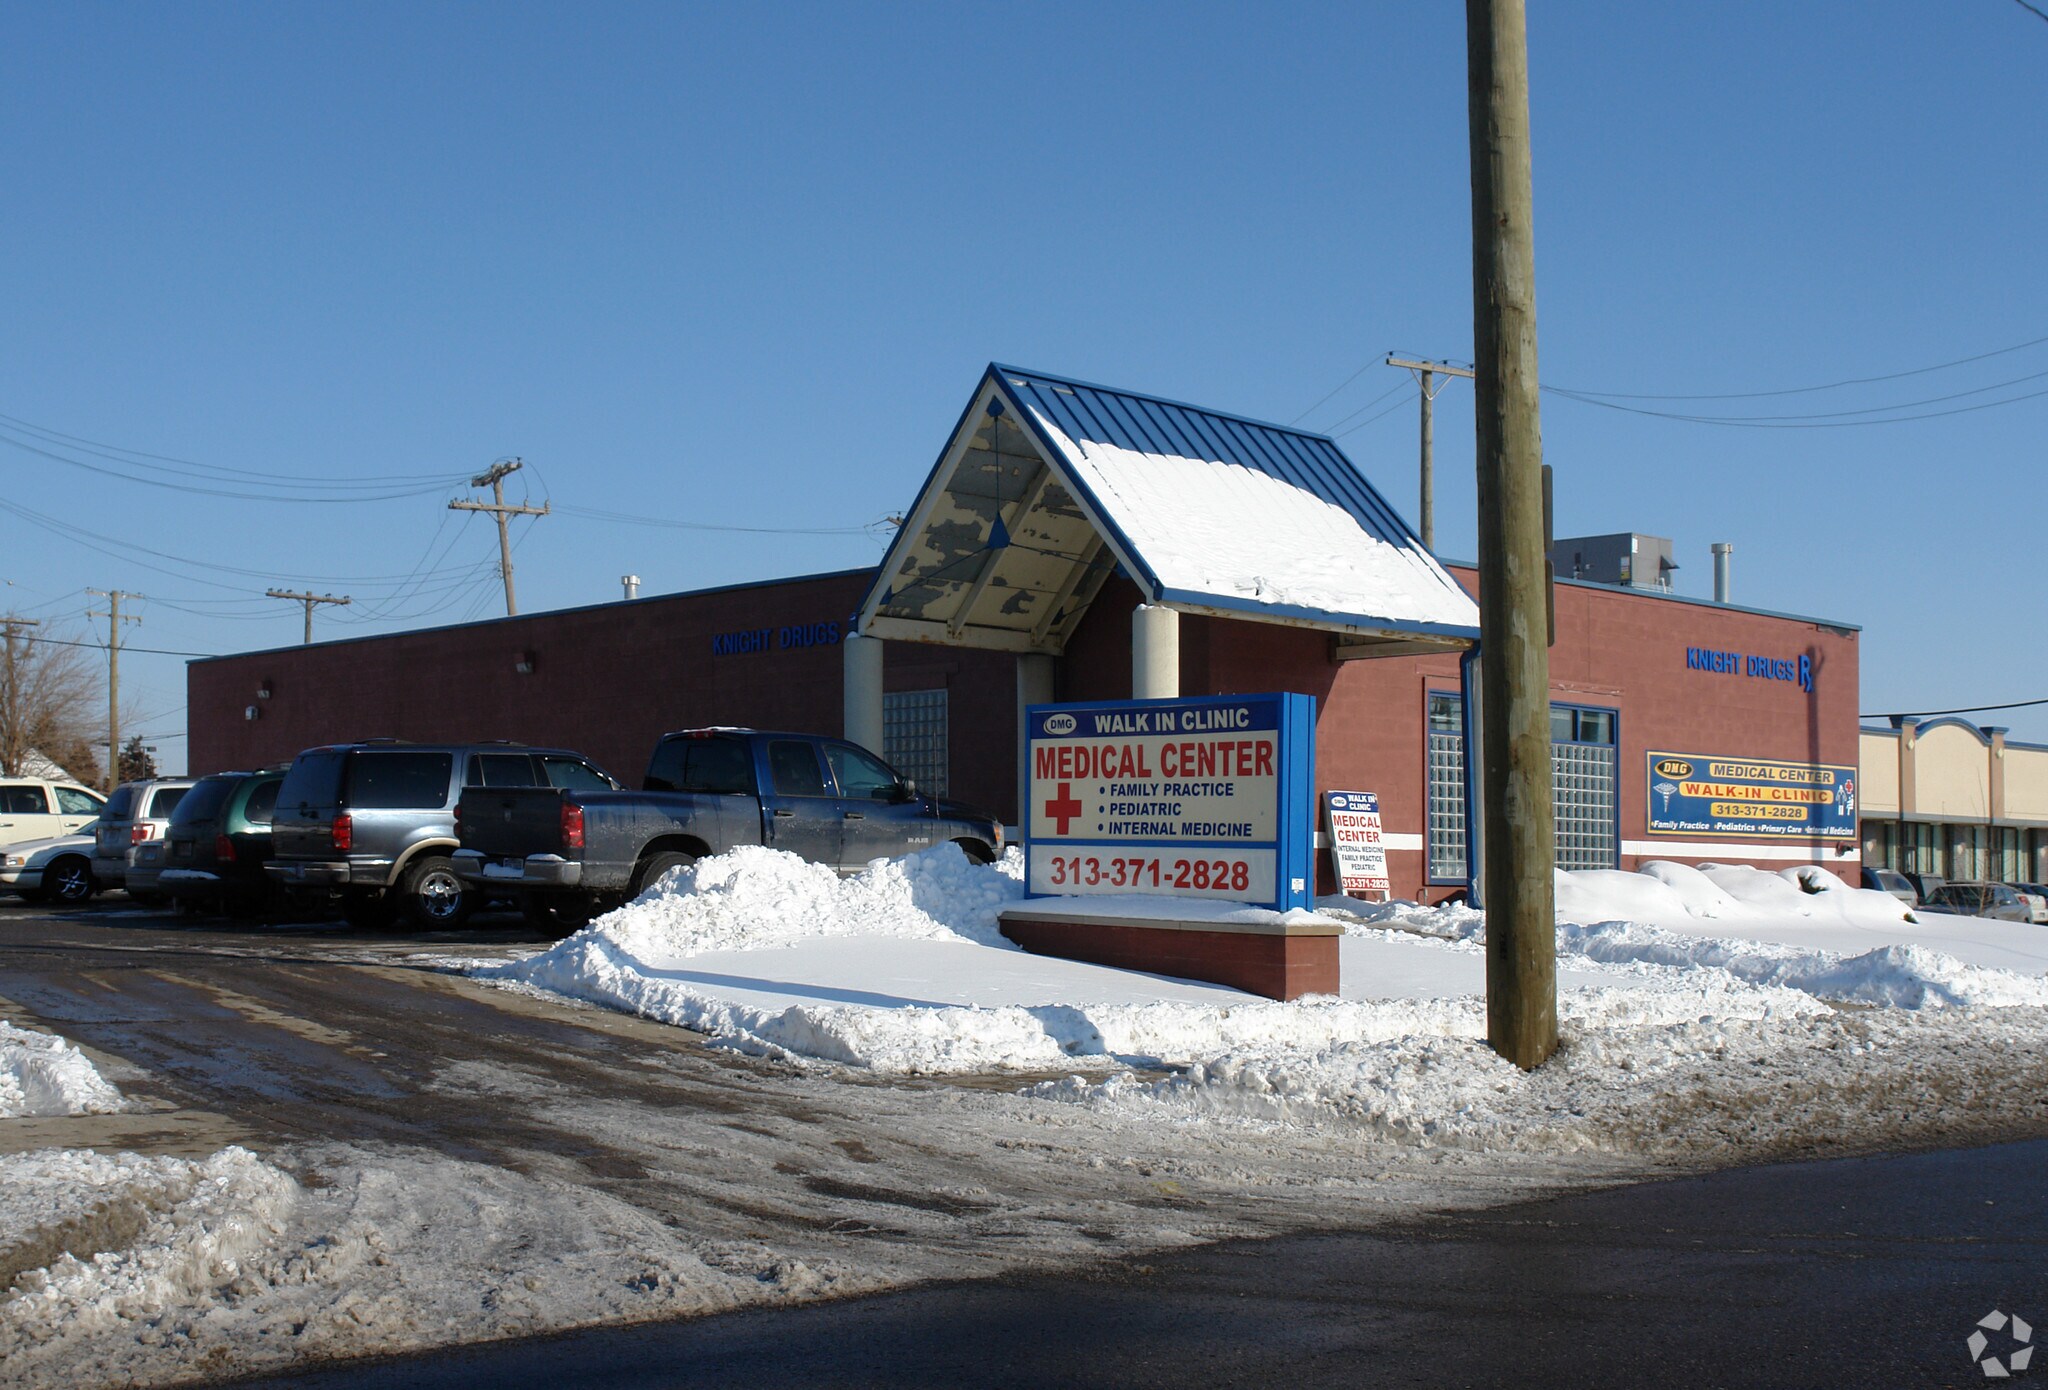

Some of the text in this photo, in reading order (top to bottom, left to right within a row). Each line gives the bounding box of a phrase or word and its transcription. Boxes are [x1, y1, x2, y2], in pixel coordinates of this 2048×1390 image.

[713, 621, 840, 656] KNIGHT DRUGS
[1687, 647, 1741, 675] KNIGHT
[1747, 655, 1795, 681] DRUGS
[1050, 719, 1073, 729] DMG
[1095, 708, 1250, 733] WALK IN CLINIC
[1036, 740, 1274, 779] MEDICAL CENTER
[1663, 762, 1688, 774] DMG
[1714, 765, 1831, 783] MEDICAL CENTER
[1110, 783, 1234, 797] FAMILY PRACTICE
[1686, 783, 1828, 802] WALK-IN CLINIC
[1348, 795, 1367, 803] WALK
[1110, 803, 1182, 816] PEDIATRIC
[1349, 803, 1371, 811] CLINIC
[1716, 805, 1802, 818] 313-371-2828
[1333, 815, 1380, 829] MEDICAL
[1653, 820, 1678, 831] Family
[1679, 821, 1710, 830] Practice
[1716, 822, 1756, 832] Pediatrics
[1761, 824, 1786, 834] Primary
[1787, 825, 1802, 834] Care
[1108, 822, 1252, 837] INTERNAL MEDICINE
[1338, 830, 1380, 843] CENTER
[1051, 857, 1249, 891] 313-371-2828
